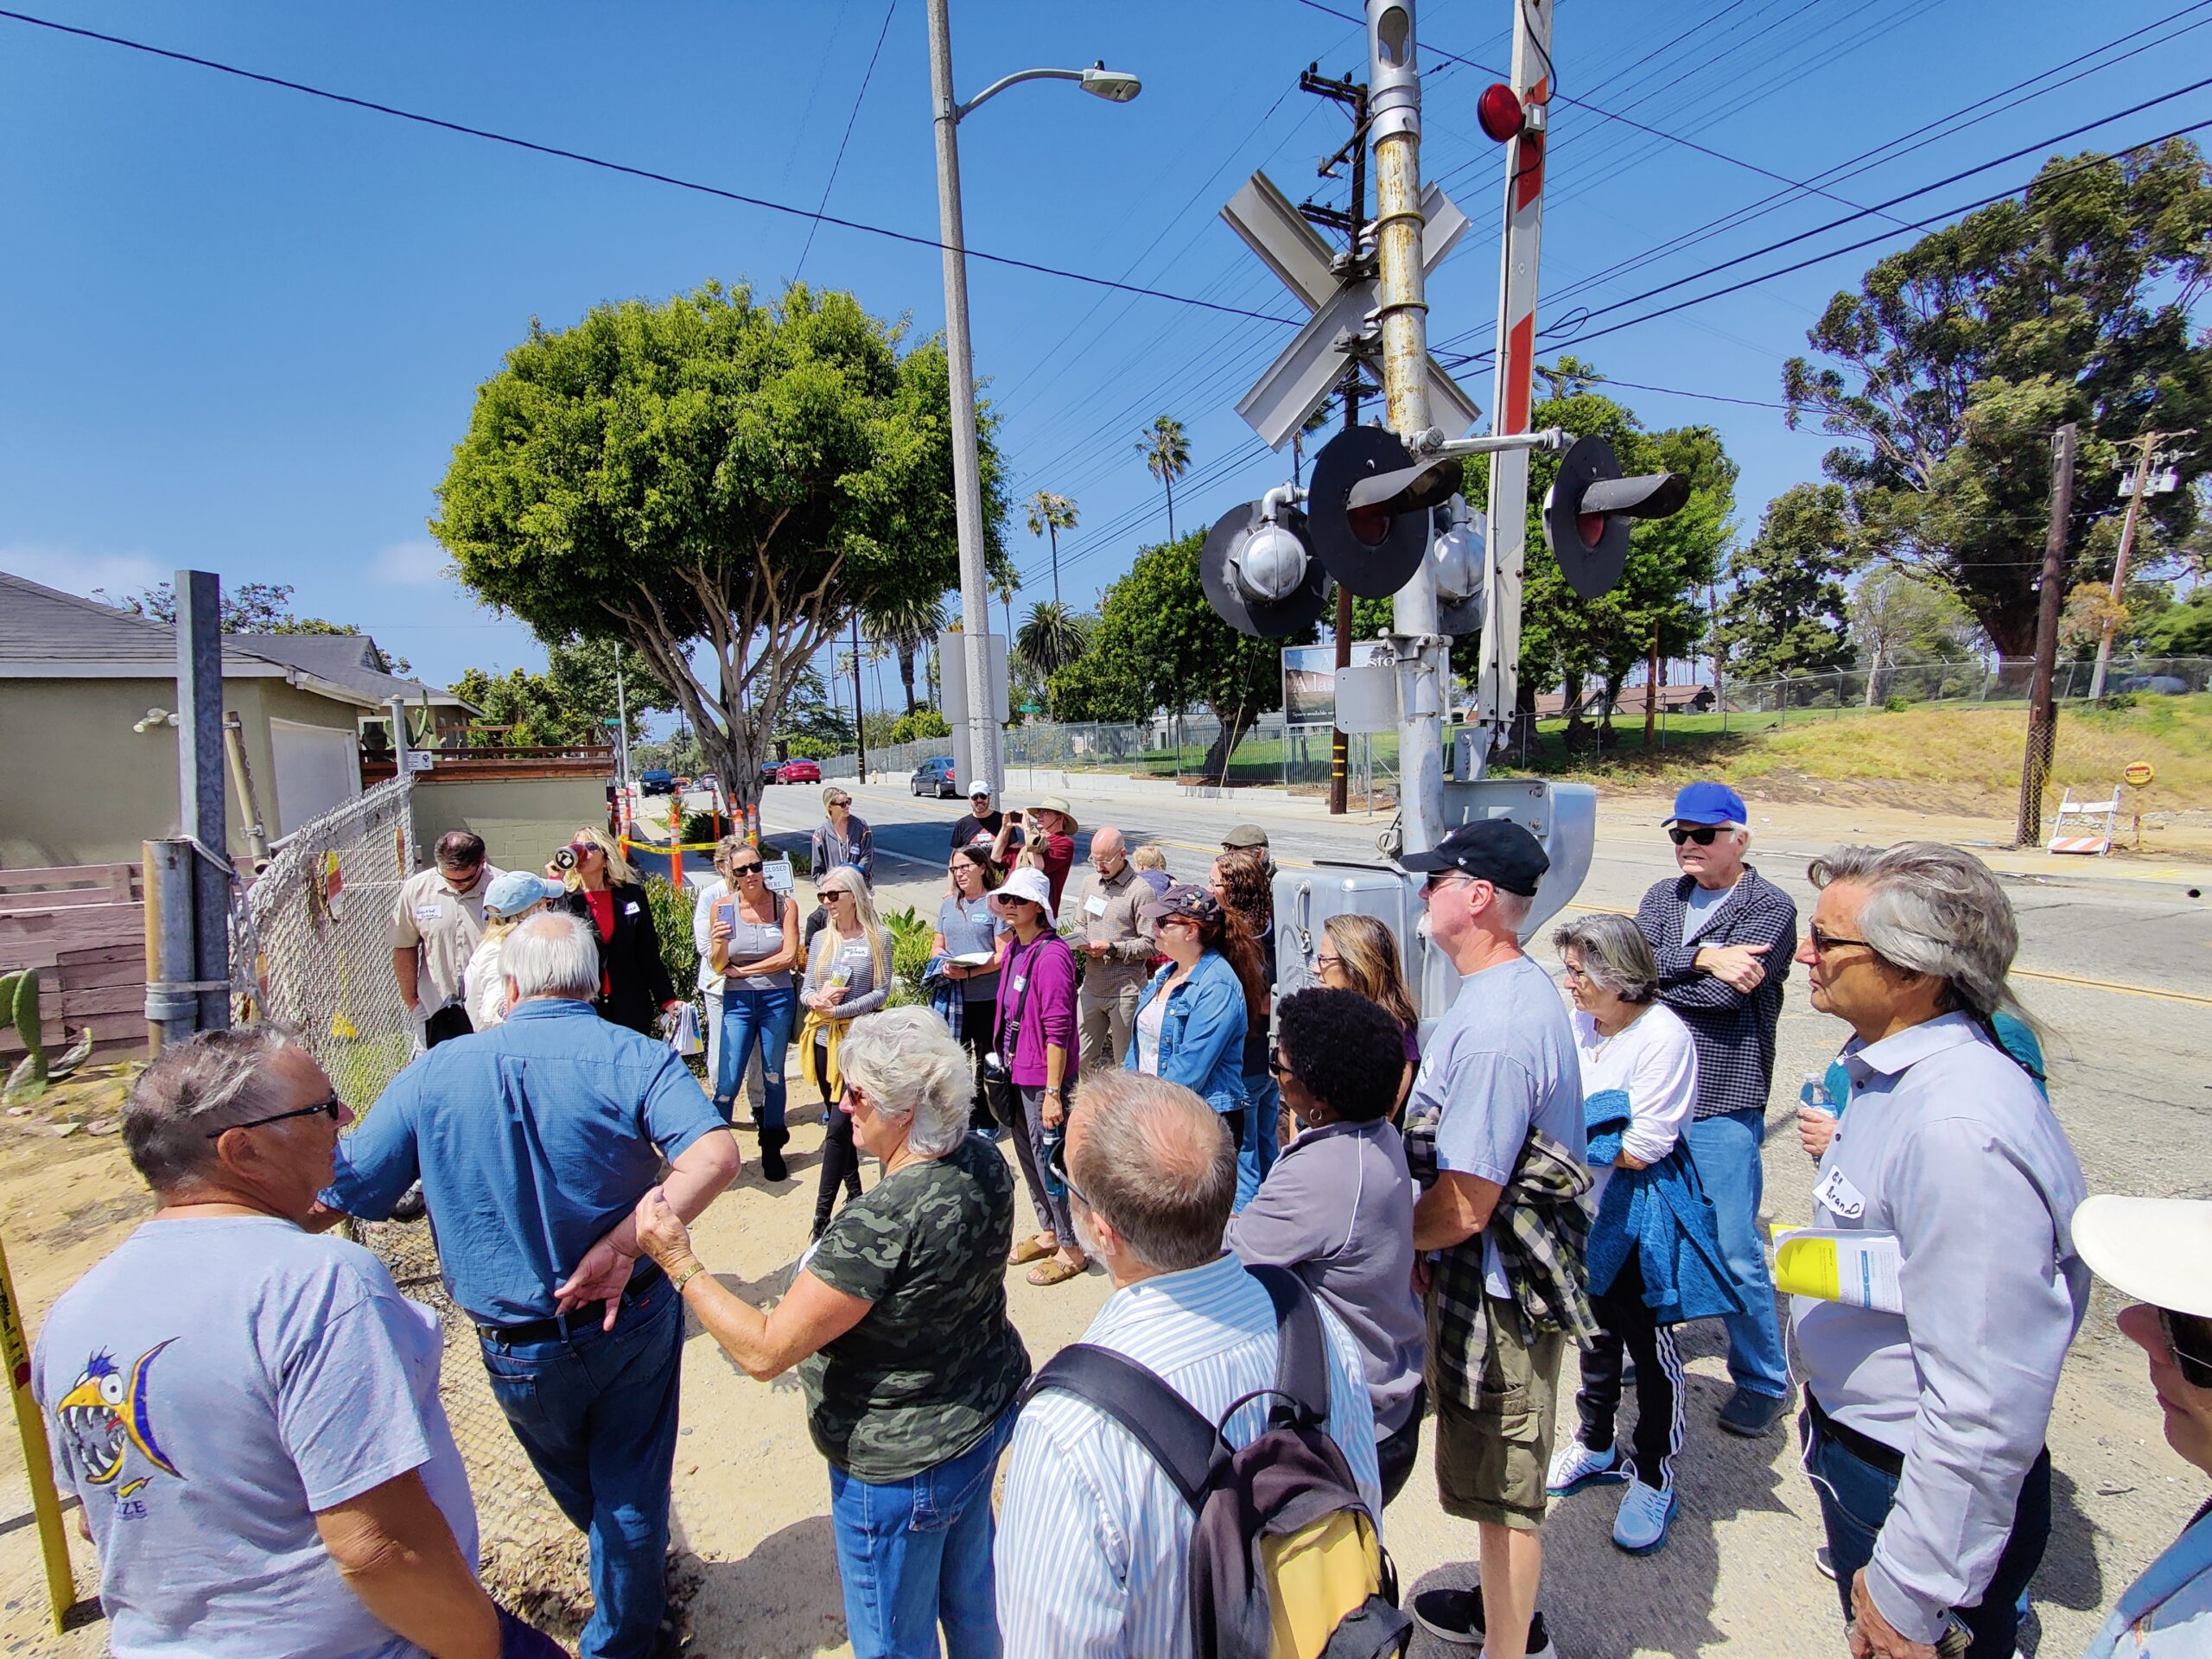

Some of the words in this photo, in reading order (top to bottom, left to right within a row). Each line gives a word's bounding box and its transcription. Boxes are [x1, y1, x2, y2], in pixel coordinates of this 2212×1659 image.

[1368, 654, 1395, 668] sto
[1293, 676, 1309, 694] A
[1312, 674, 1335, 692] las
